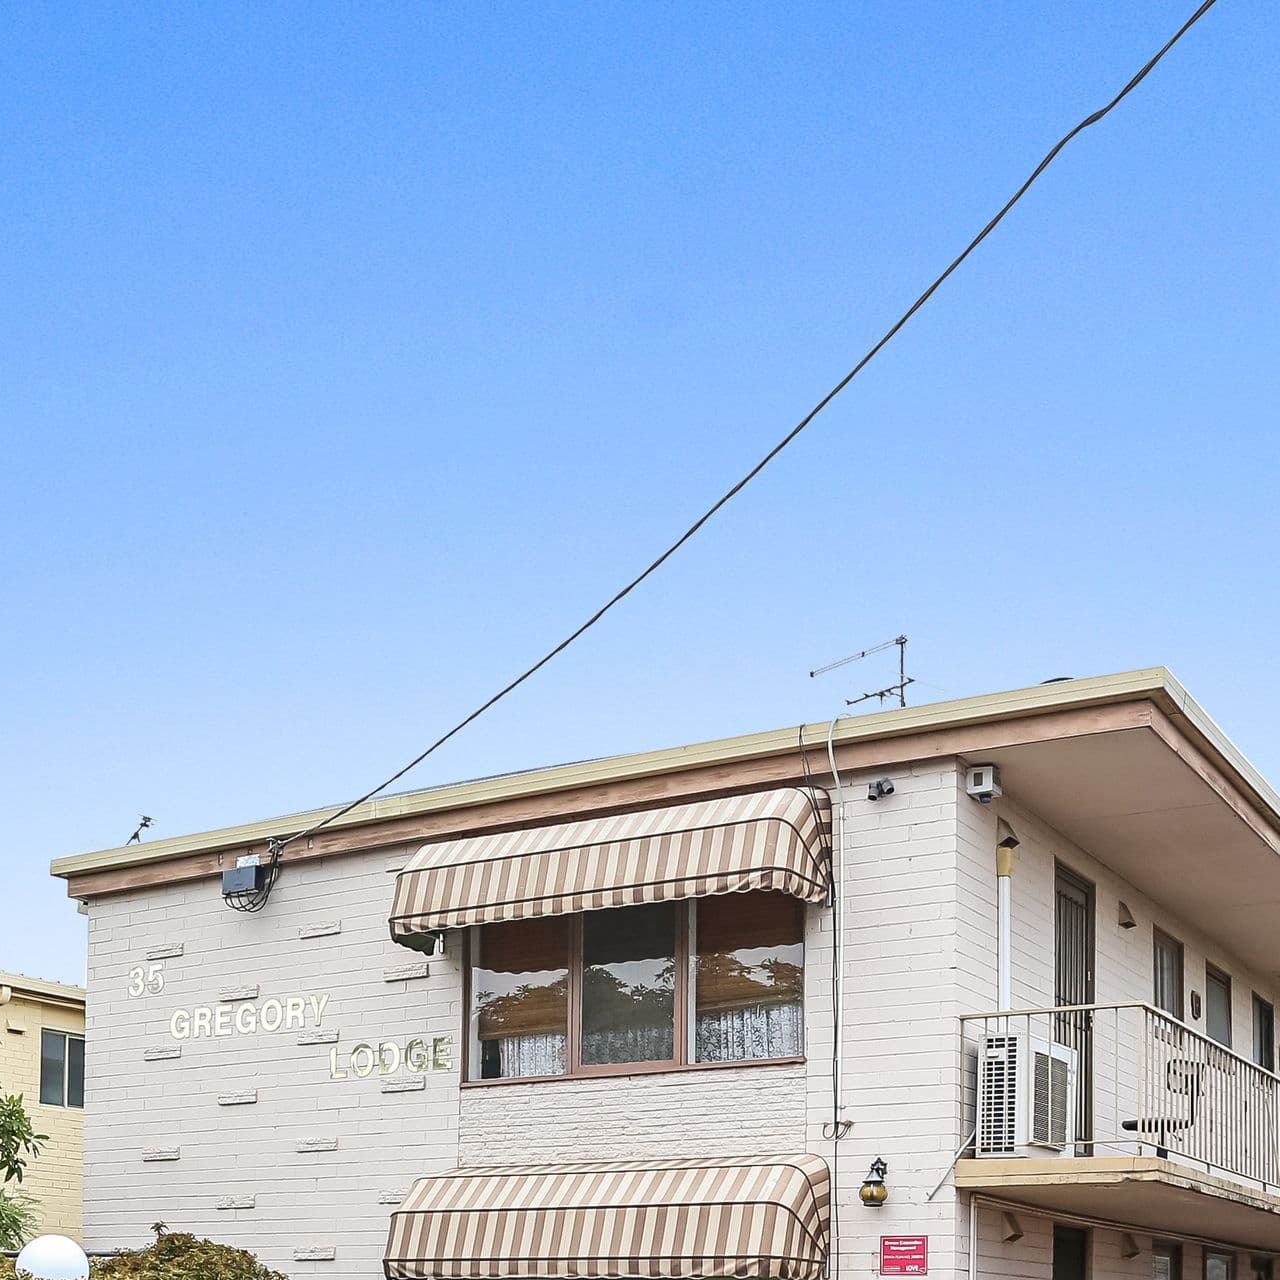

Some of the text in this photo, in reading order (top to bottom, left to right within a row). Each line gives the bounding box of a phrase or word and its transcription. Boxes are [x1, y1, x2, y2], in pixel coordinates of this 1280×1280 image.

[128, 964, 165, 997] 35
[170, 993, 331, 1040] GREGORY
[328, 1035, 453, 1080] LODGE
